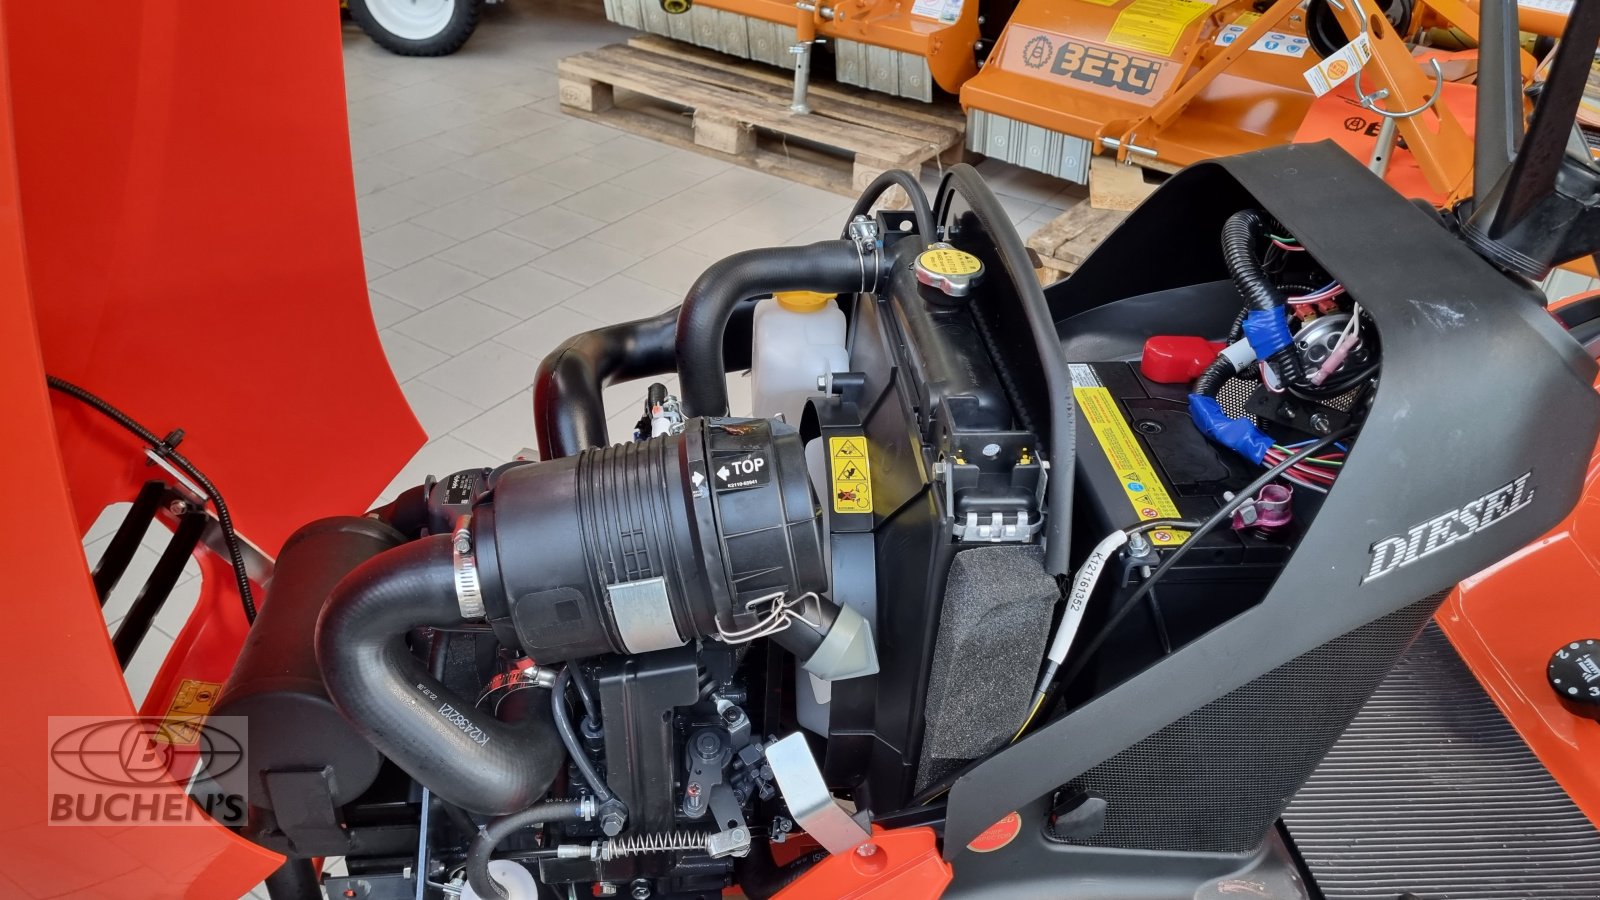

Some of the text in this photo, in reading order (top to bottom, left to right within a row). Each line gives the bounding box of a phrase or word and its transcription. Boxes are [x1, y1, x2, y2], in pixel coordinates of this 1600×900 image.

[731, 458, 765, 475] TOP
[1361, 469, 1536, 584] DIESEL
[1070, 552, 1104, 612] K121161352
[1555, 649, 1570, 660] 2
[437, 702, 490, 748] K124382121
